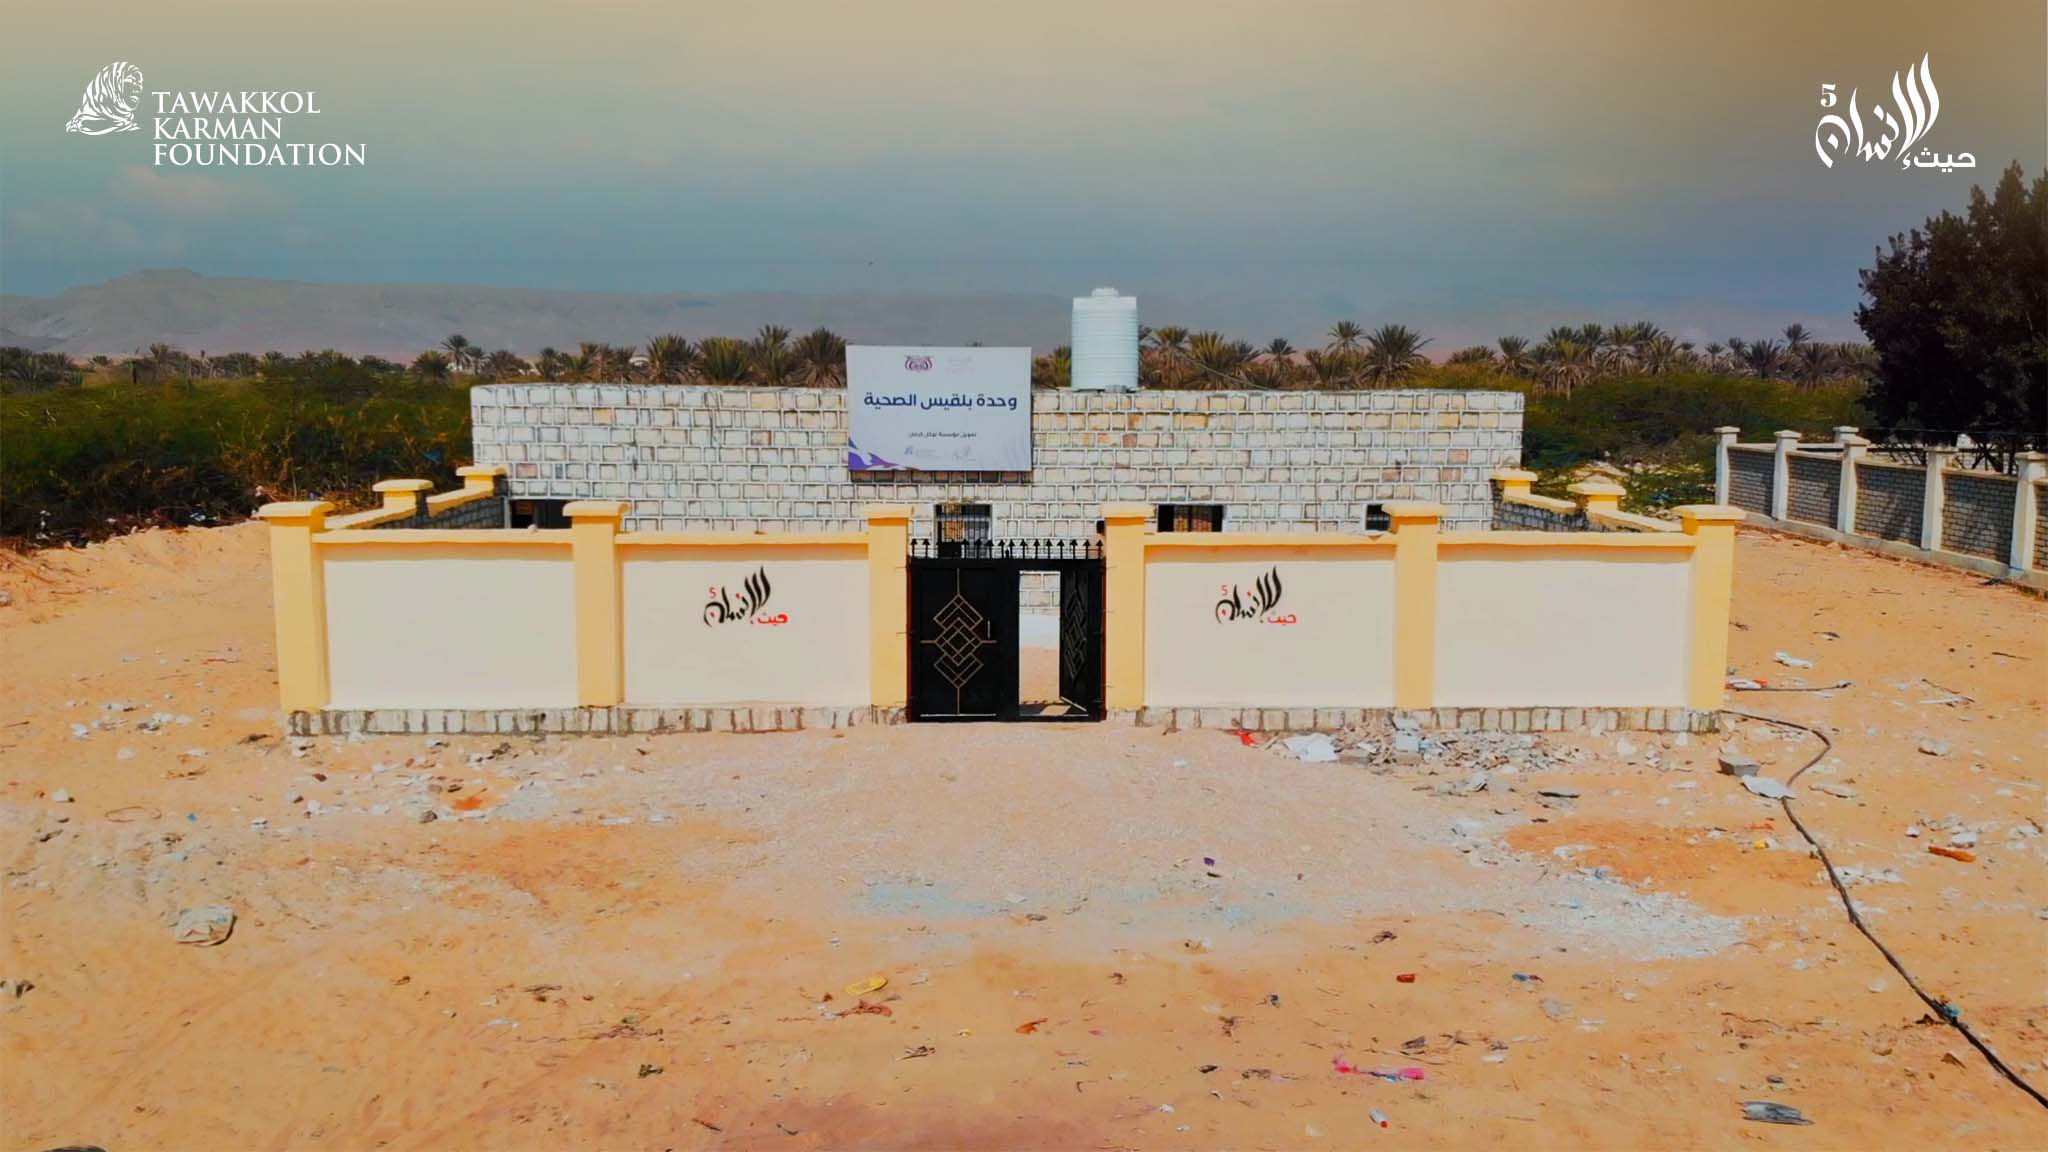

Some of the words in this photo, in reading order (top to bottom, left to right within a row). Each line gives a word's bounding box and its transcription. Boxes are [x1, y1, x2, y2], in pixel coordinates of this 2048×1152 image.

[864, 392, 917, 410] الصحية
[920, 393, 973, 411] بلقيس
[976, 393, 1018, 411] وحدة
[708, 586, 717, 599] 5
[1221, 584, 1229, 596] 5
